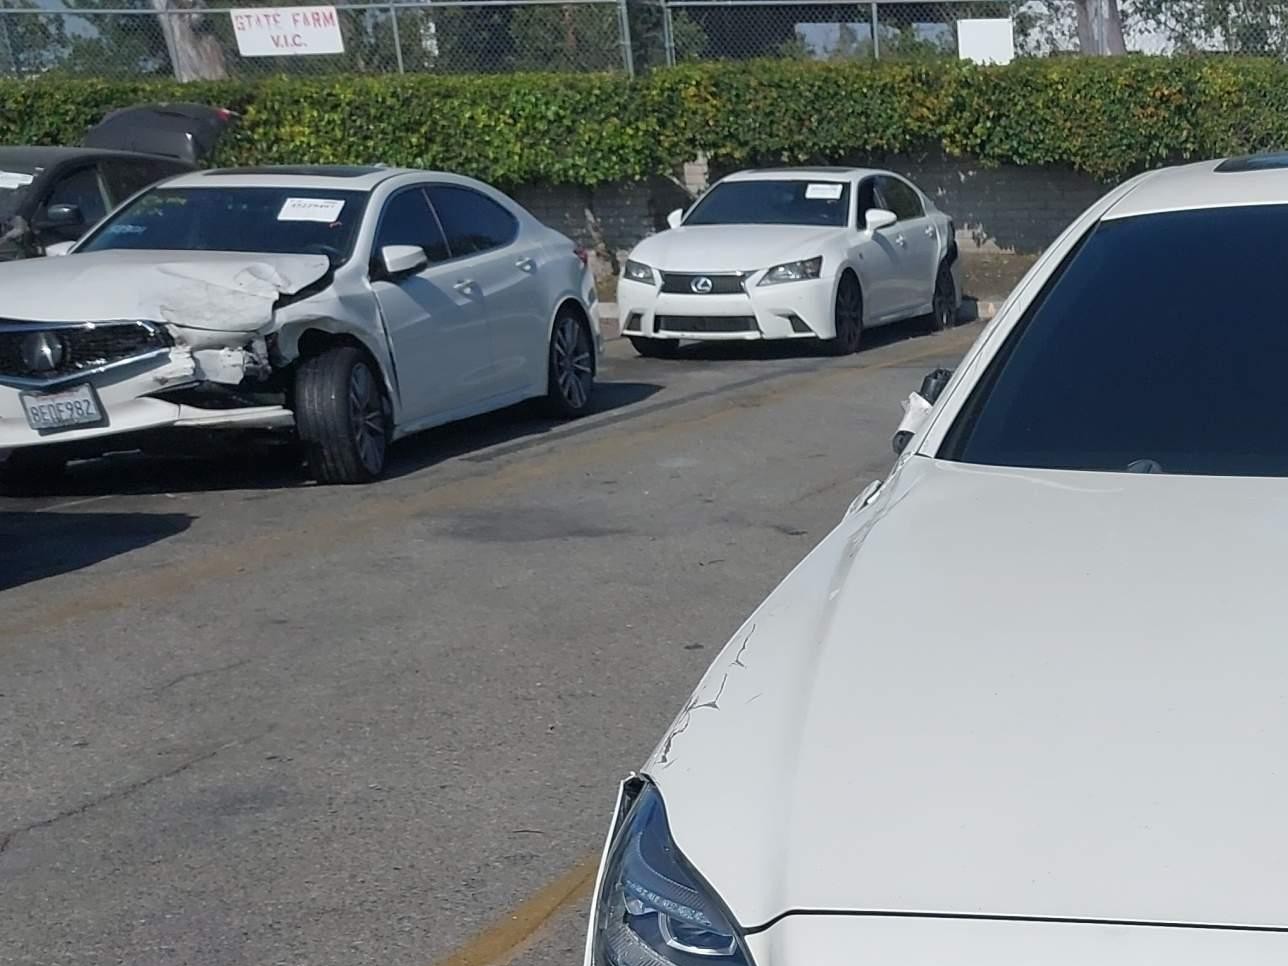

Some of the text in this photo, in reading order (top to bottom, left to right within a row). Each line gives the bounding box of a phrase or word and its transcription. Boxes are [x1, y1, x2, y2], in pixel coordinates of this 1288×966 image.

[235, 11, 336, 31] STATE FARM
[271, 34, 308, 48] V.I.C.
